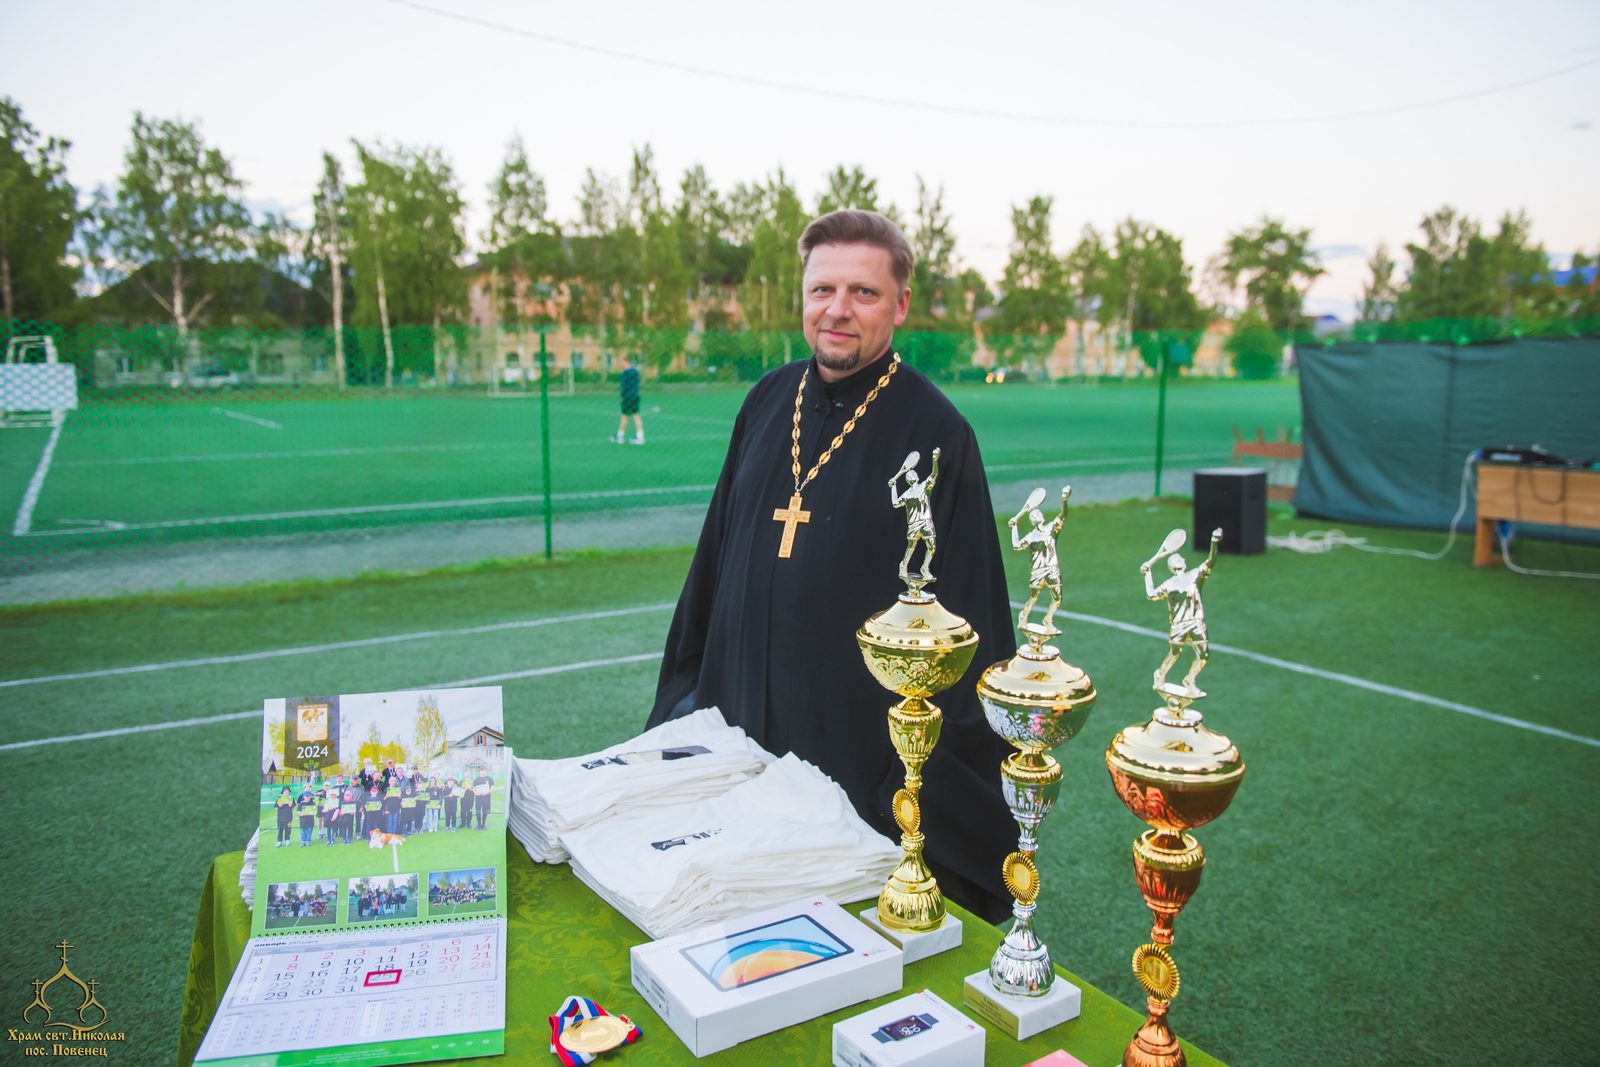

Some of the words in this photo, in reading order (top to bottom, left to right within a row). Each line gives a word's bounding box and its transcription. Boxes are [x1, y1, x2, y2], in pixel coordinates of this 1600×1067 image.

[297, 745, 328, 758] 2024
[408, 951, 429, 959] 12
[441, 946, 460, 955] 13
[274, 972, 294, 981] 15
[342, 966, 361, 975] 17
[408, 959, 428, 967] 19
[439, 955, 460, 964] 20
[471, 952, 490, 960] 21
[337, 976, 358, 984] 24
[404, 969, 426, 977] 26
[264, 992, 288, 1000] 29
[299, 989, 322, 997] 30
